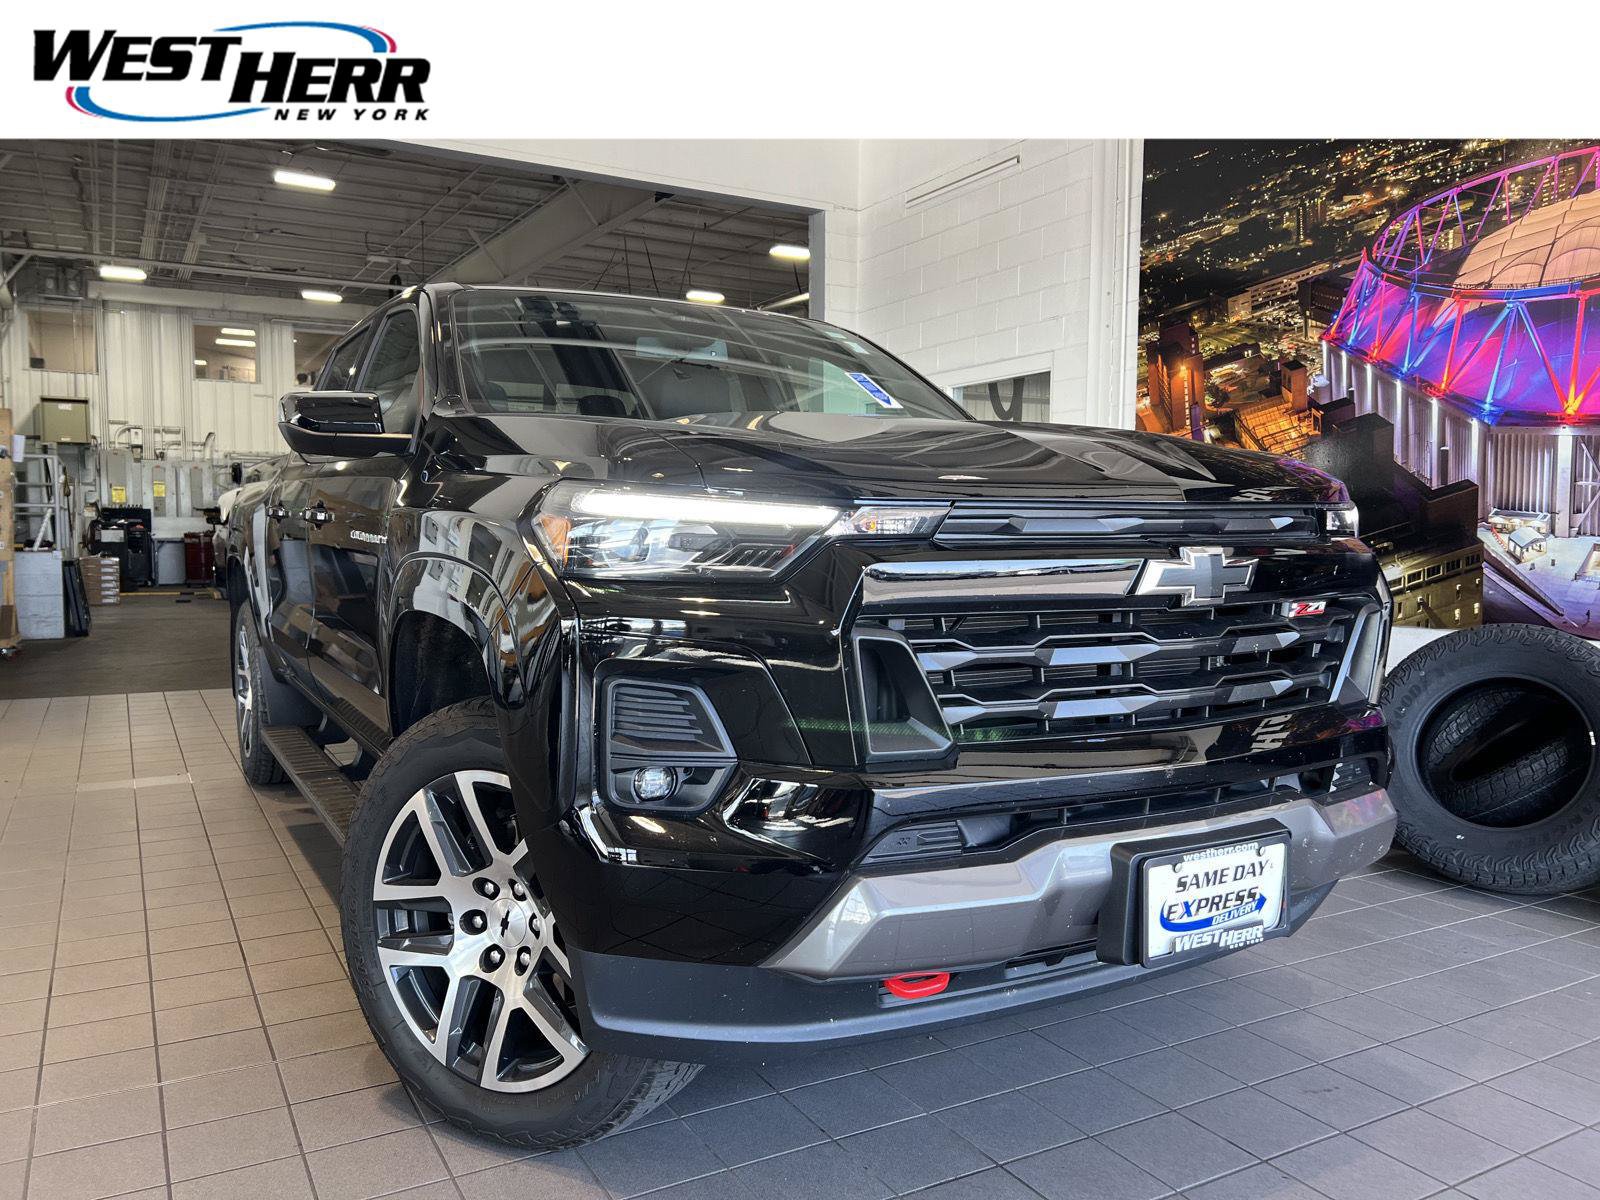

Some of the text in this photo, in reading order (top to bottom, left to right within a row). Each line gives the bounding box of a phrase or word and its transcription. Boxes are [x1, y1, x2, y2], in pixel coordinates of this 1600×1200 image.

[1183, 842, 1258, 862] westherr.com
[1175, 859, 1269, 893] SAME DAY
[1166, 886, 1258, 922] EXPRESS
[1212, 900, 1257, 925] DELIVERY
